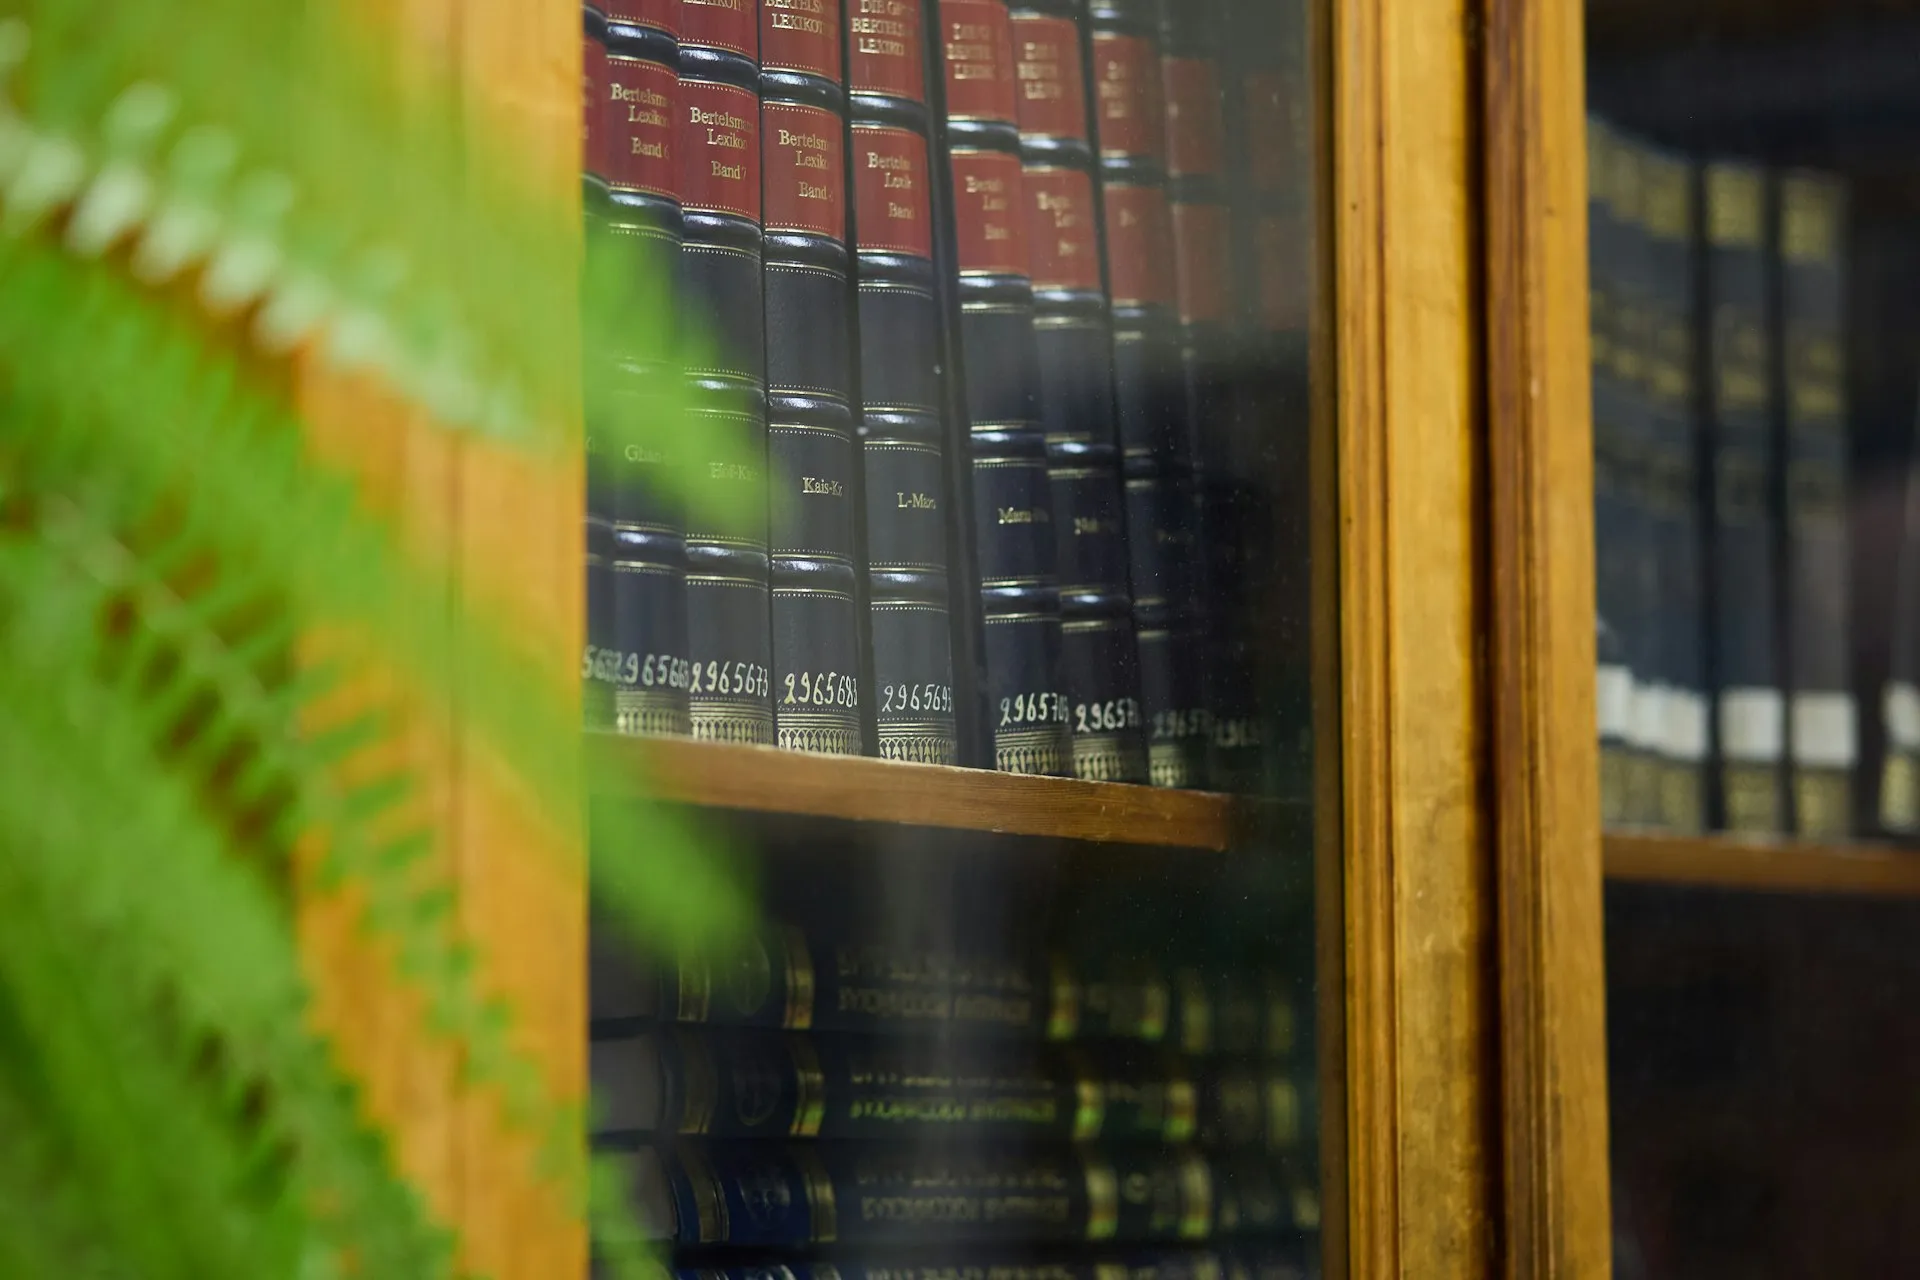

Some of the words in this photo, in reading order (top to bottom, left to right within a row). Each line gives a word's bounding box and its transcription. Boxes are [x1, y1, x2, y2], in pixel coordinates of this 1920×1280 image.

[631, 137, 663, 158] Band
[711, 160, 741, 180] Band
[798, 181, 828, 200] Band
[689, 660, 769, 697] 2965673
[784, 671, 858, 708] 2965683
[881, 683, 953, 714] 2965693
